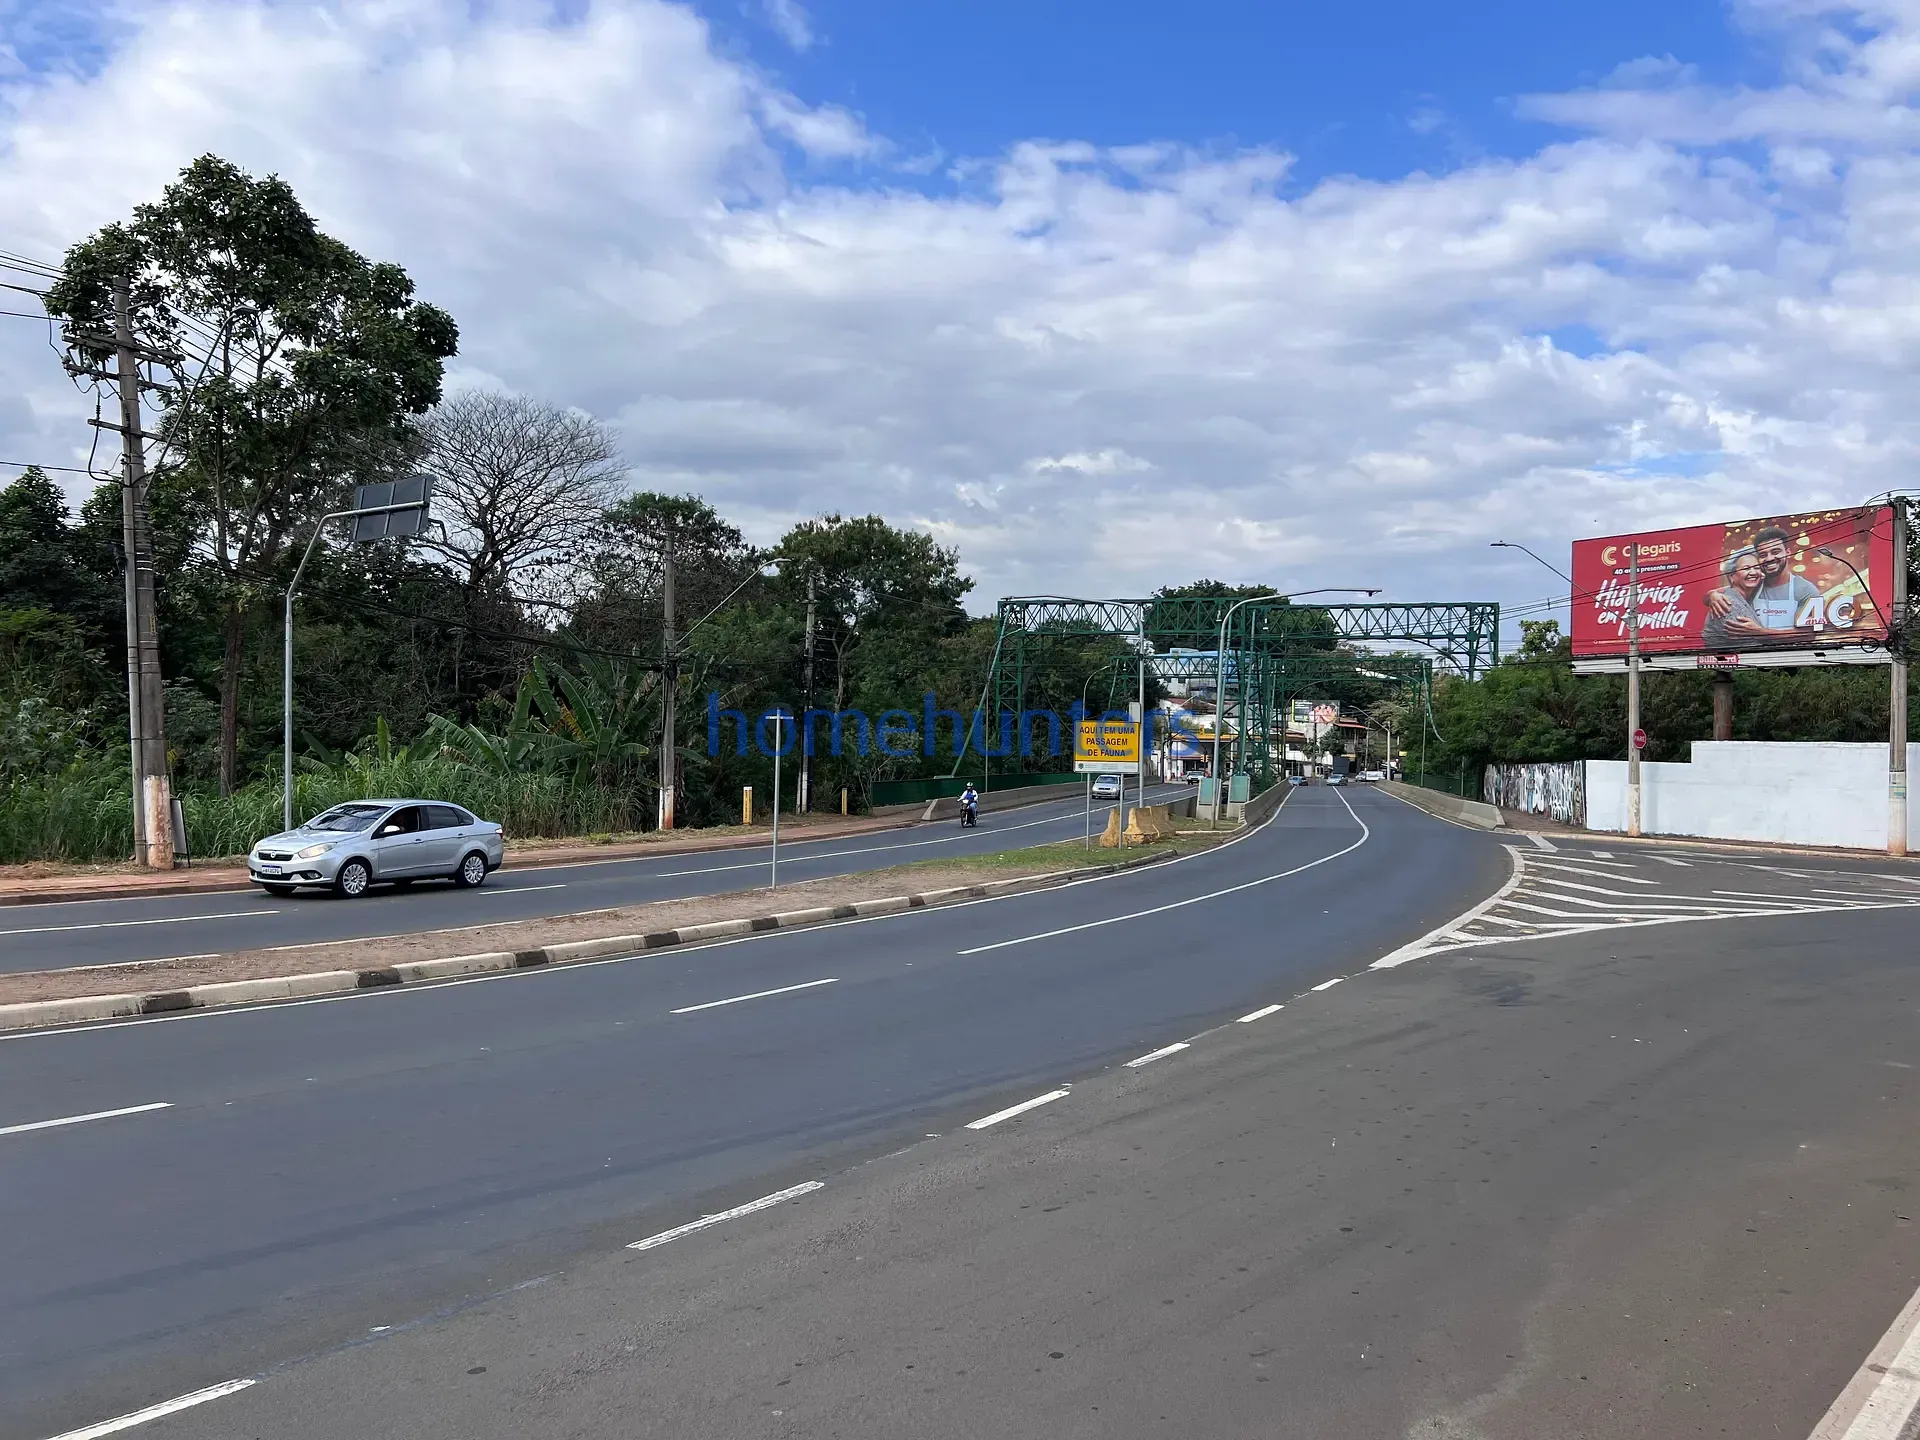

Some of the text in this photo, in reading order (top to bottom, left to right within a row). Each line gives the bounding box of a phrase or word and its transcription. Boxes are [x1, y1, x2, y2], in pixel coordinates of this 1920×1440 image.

[1622, 541, 1681, 557] Clegaris
[1640, 565, 1666, 574] presente
[1597, 610, 1619, 624] em
[1699, 654, 1737, 663] Billbrd
[1079, 726, 1135, 735] AQUI TEM UMA
[1086, 737, 1128, 746] PASSAGEM
[1087, 749, 1126, 757] DE FAUNA
